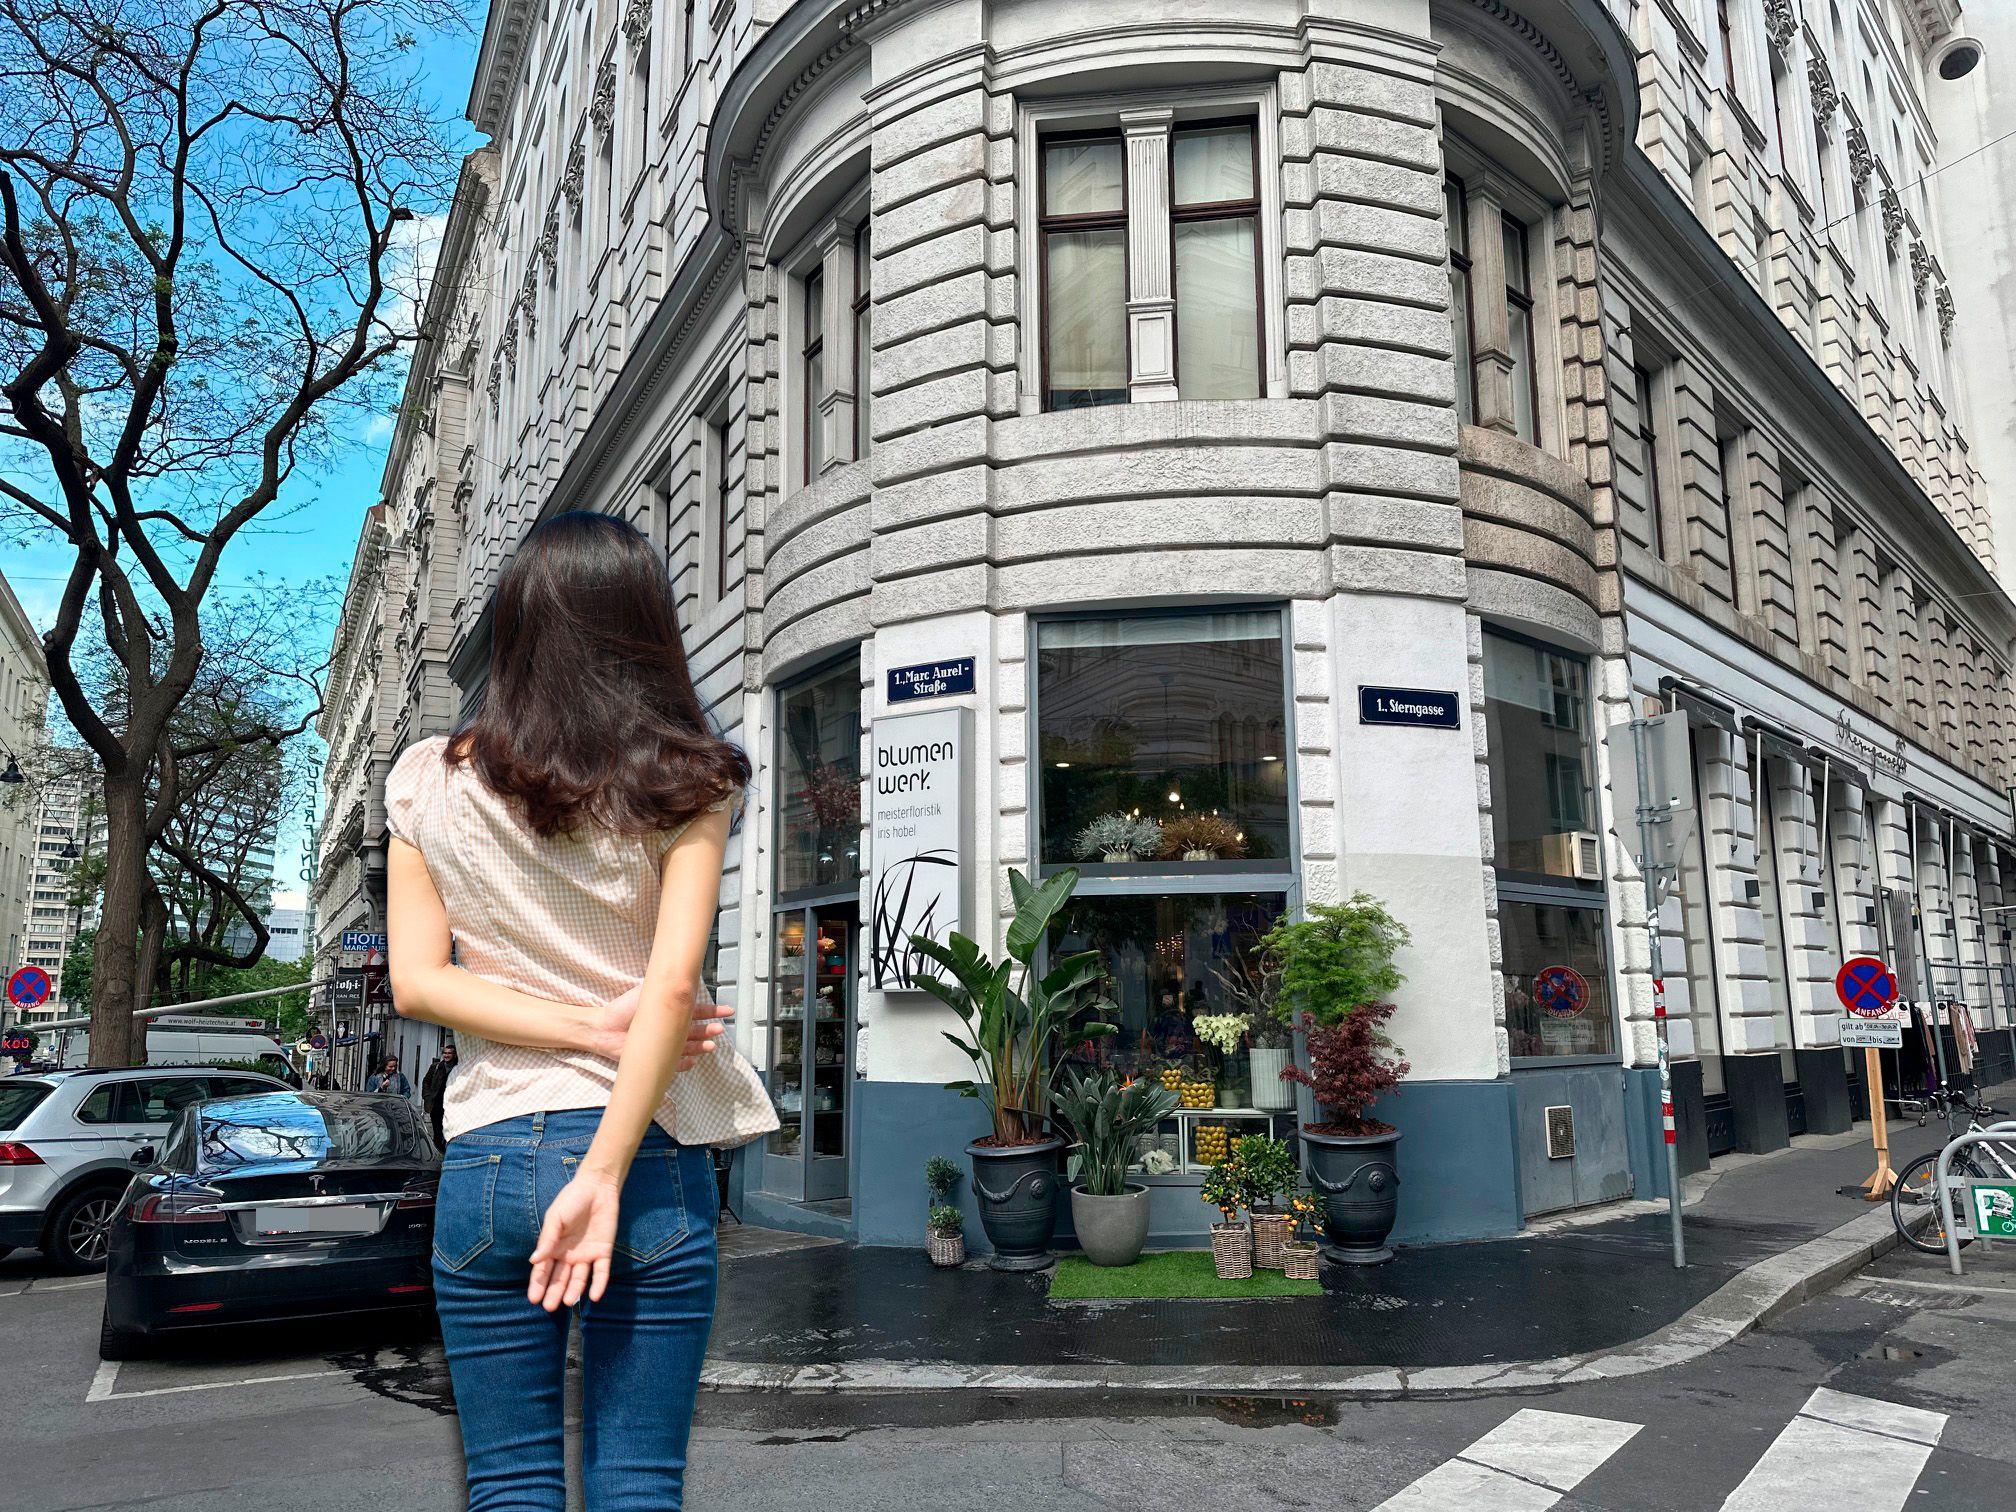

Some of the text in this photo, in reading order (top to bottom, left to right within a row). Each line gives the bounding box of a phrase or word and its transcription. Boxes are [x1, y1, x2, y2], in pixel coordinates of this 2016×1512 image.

[932, 663, 963, 680] Aurel
[913, 680, 947, 695] Straße
[1389, 698, 1444, 718] Sterngasse
[878, 741, 953, 767] blumen
[878, 768, 930, 795] werk.
[877, 803, 942, 821] meisterfloristik
[877, 824, 916, 839] iris hobel
[343, 944, 368, 952] MARC
[15, 1000, 41, 1009] ANFANG
[1854, 1005, 1888, 1017] ANFANG
[1841, 1022, 1854, 1031] gilt
[1854, 1022, 1864, 1031] ab
[1872, 1035, 1883, 1044] bis
